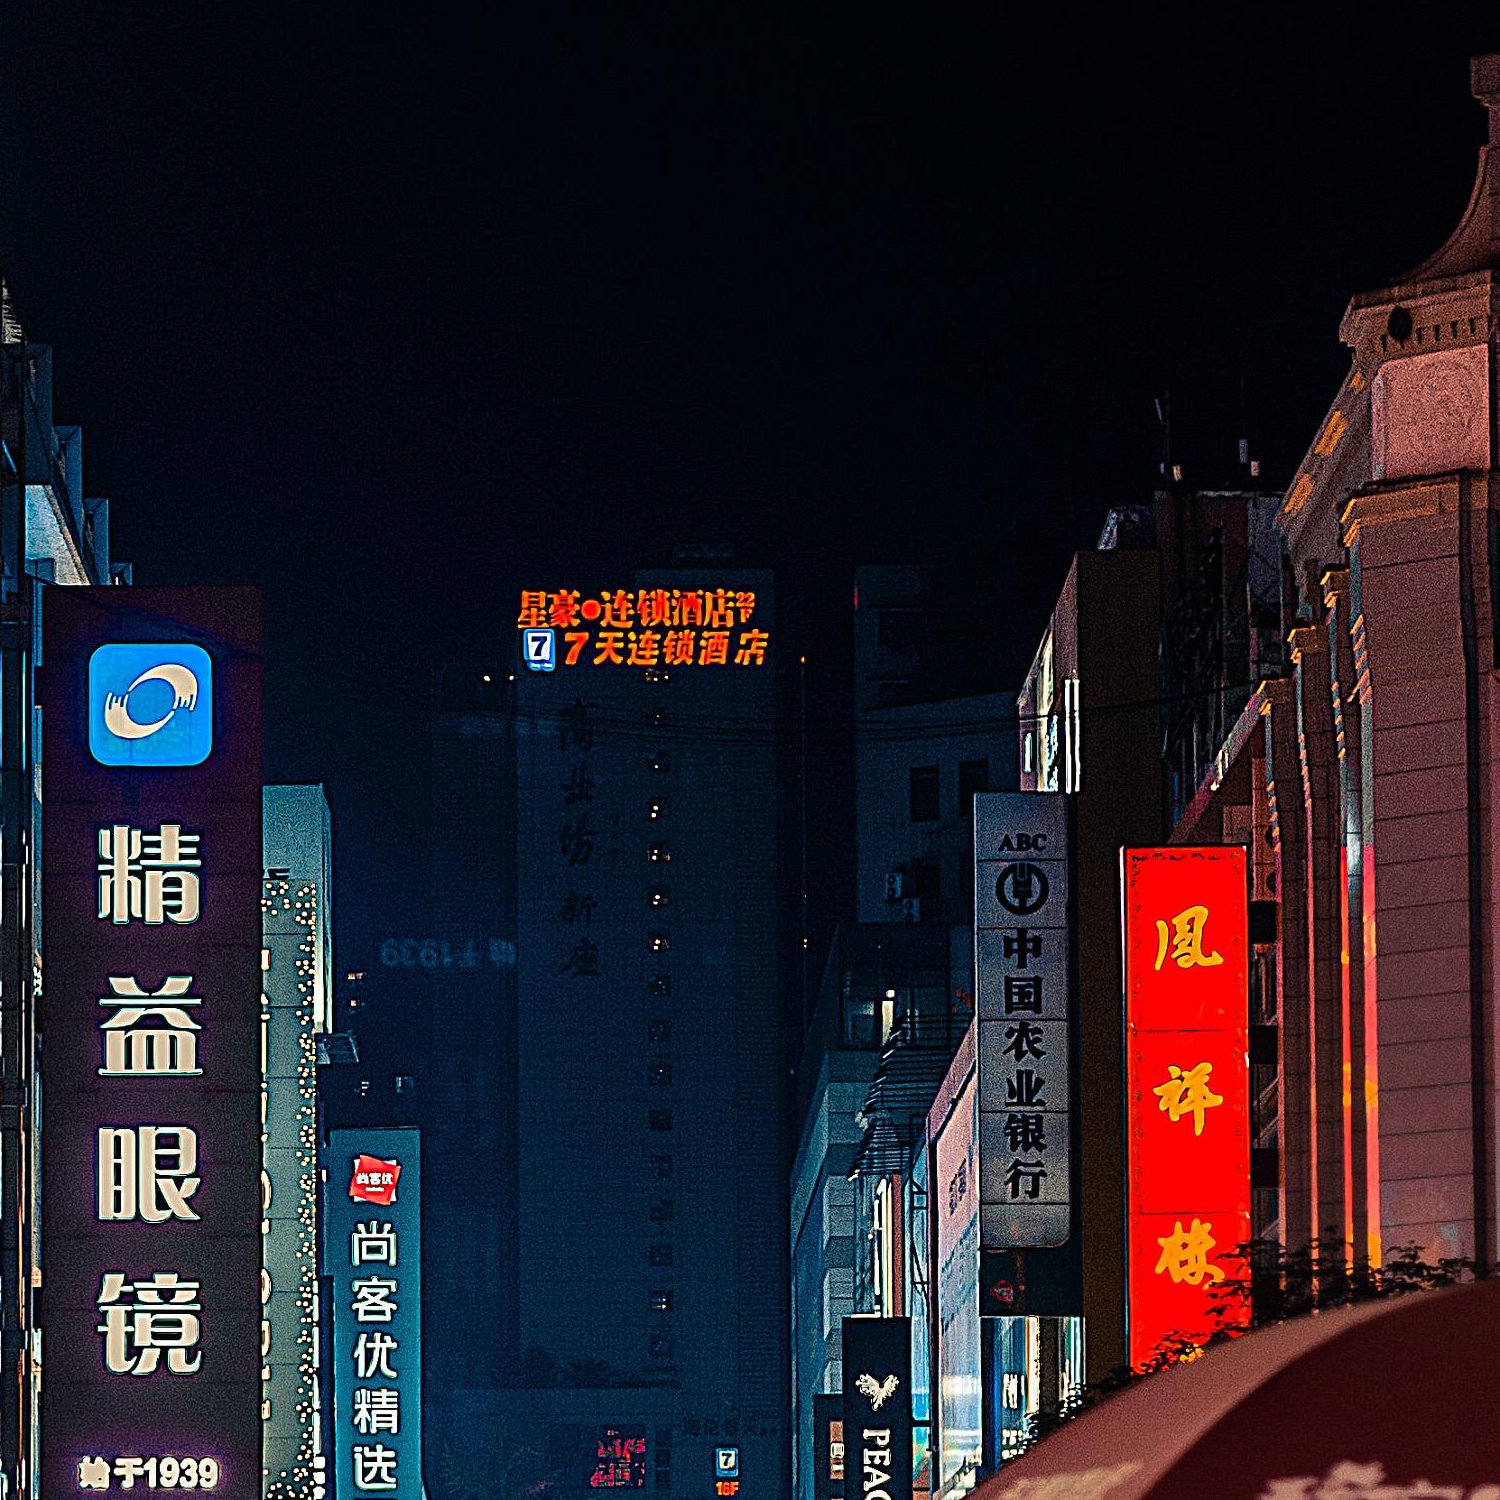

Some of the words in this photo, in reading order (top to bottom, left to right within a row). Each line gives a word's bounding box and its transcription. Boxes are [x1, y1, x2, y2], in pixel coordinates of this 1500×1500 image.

[564, 629, 770, 666] 7天连锁酒店
[1000, 833, 1048, 852] ABC
[1002, 927, 1048, 1200] 中国农业银行
[97, 824, 204, 1376] 精益眼镜
[77, 1454, 221, 1492] 始于1939
